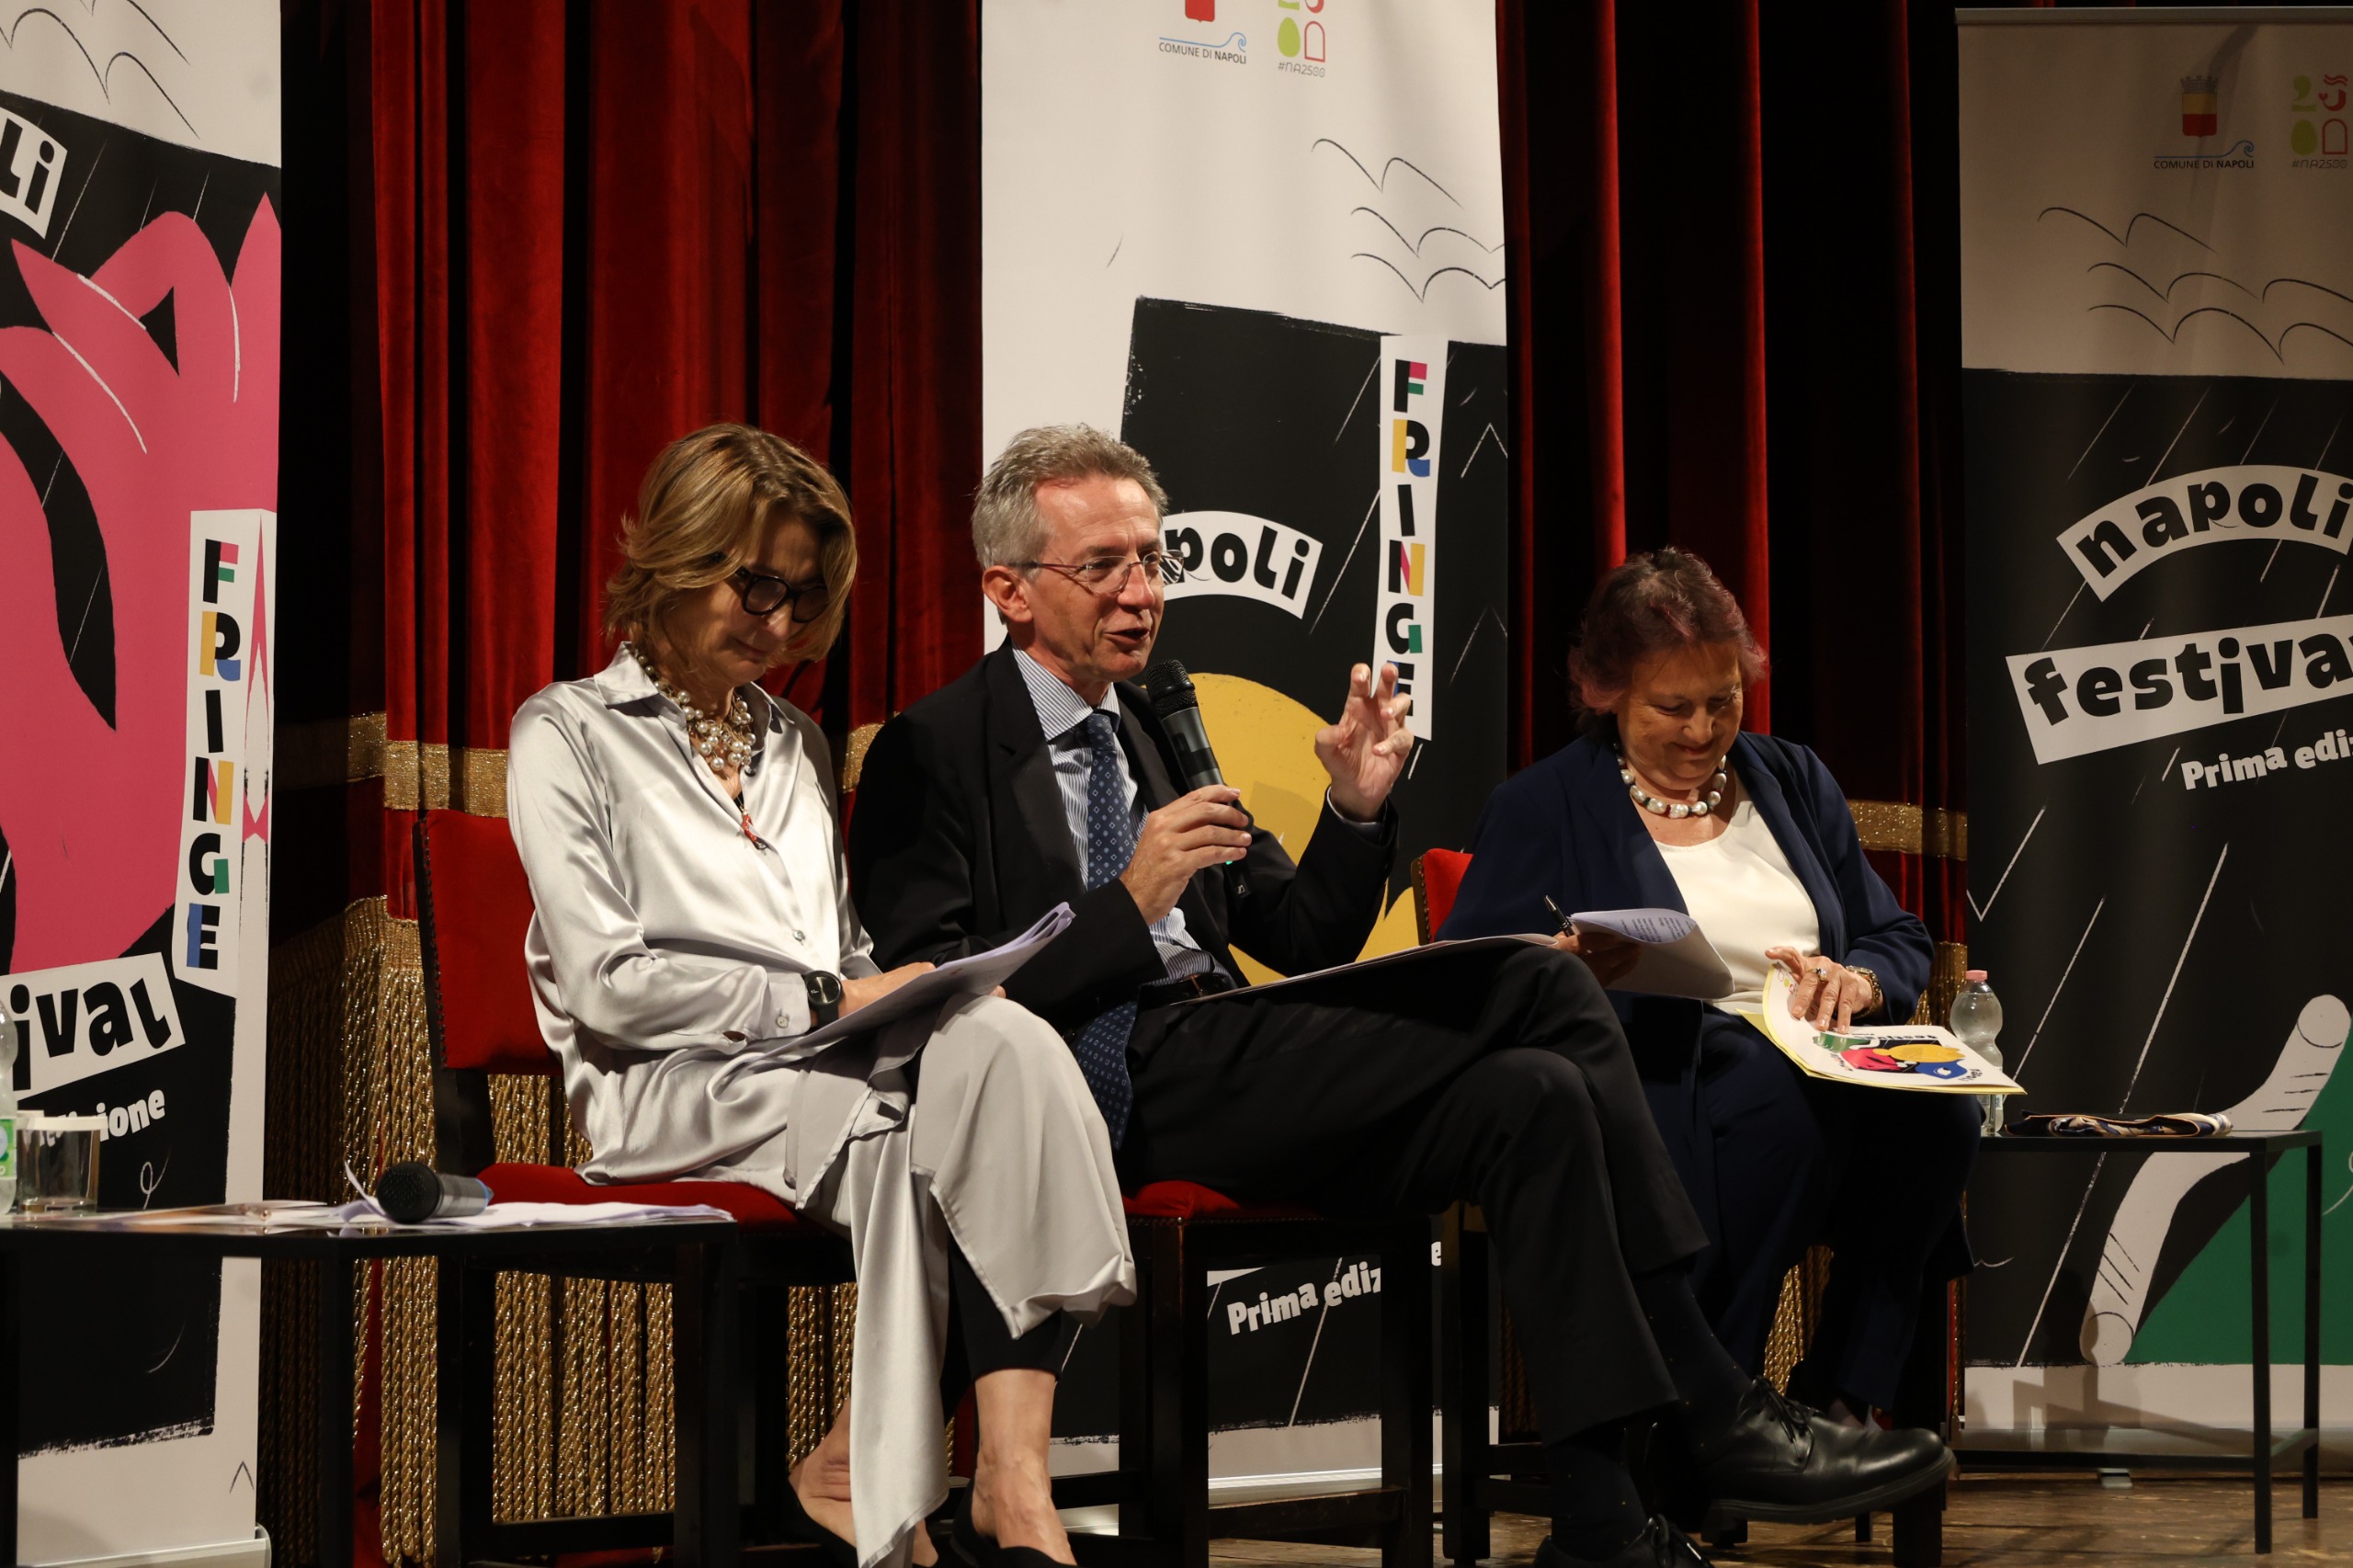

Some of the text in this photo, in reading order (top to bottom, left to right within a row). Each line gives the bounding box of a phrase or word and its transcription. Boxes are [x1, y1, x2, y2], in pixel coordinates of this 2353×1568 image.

[1158, 42, 1246, 65] COMUNE DI NAPOLI
[2154, 160, 2255, 170] COMUNE DI NAPOLI
[2075, 473, 2353, 579] napoli
[1165, 525, 1310, 601] poli
[2024, 633, 2353, 726] festiva
[187, 539, 241, 971] FRINGE
[2181, 729, 2353, 790] Prima edi
[1227, 1283, 1318, 1335] Prima
